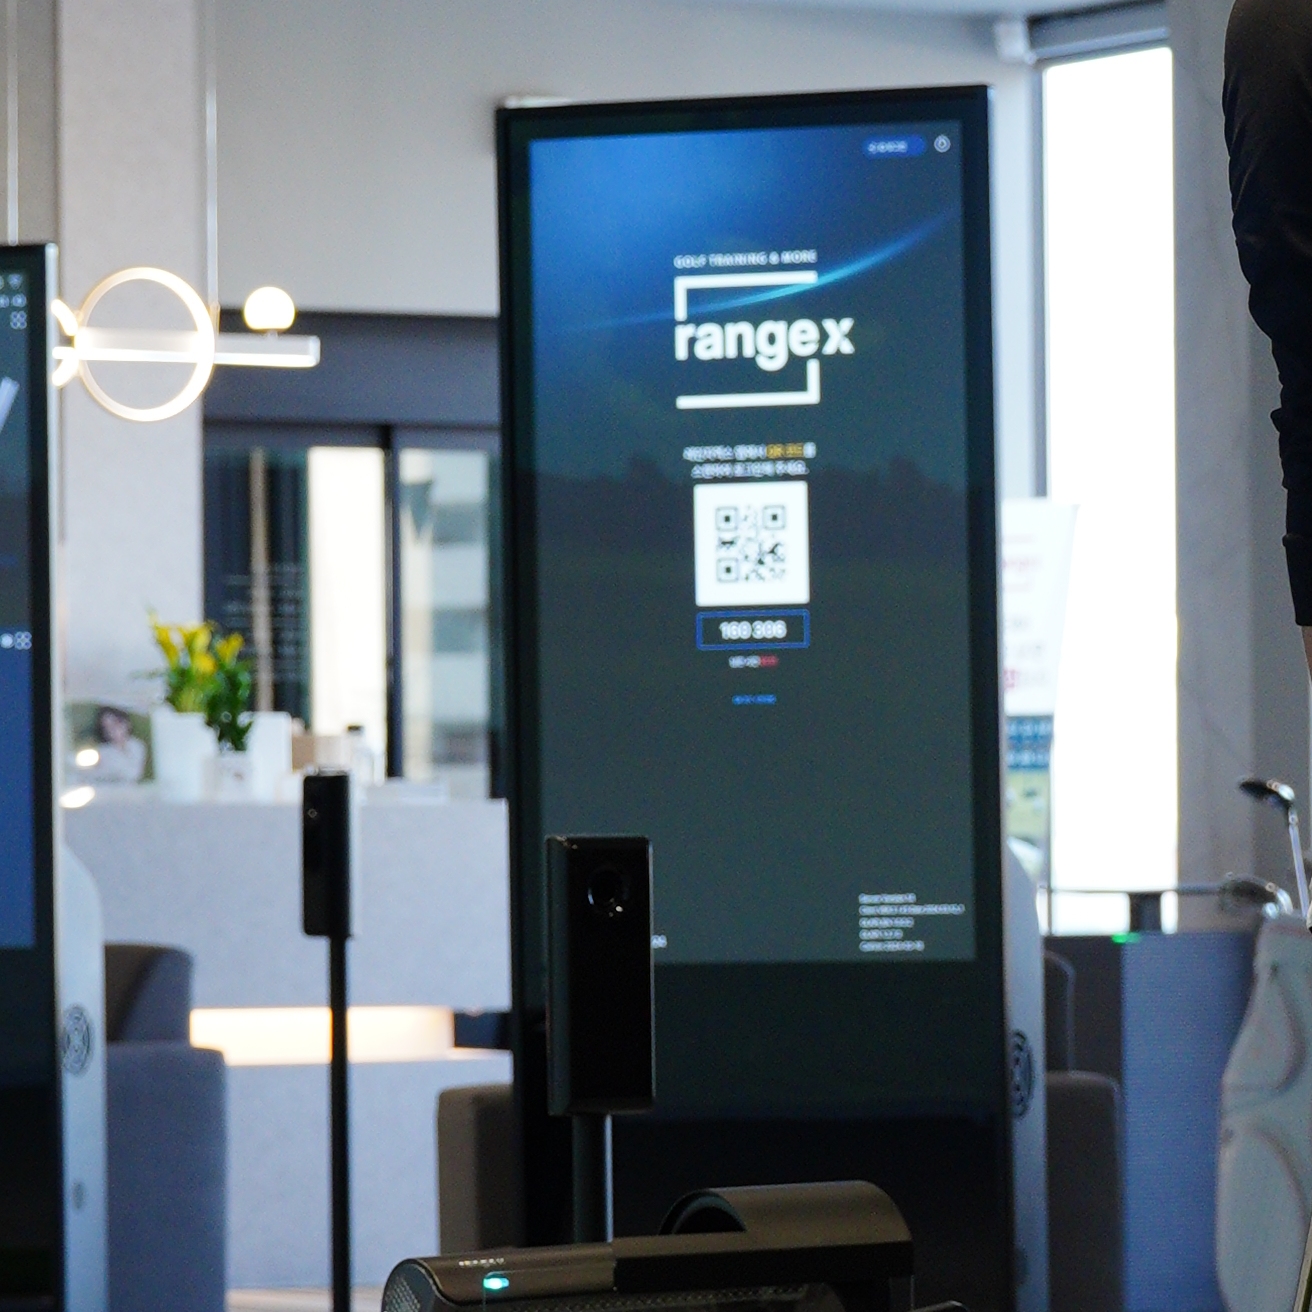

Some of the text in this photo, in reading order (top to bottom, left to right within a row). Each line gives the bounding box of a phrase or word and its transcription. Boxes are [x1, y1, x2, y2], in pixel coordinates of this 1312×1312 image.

[673, 254, 707, 269] GOLF
[709, 251, 768, 267] TRAINING
[781, 249, 818, 264] MORE
